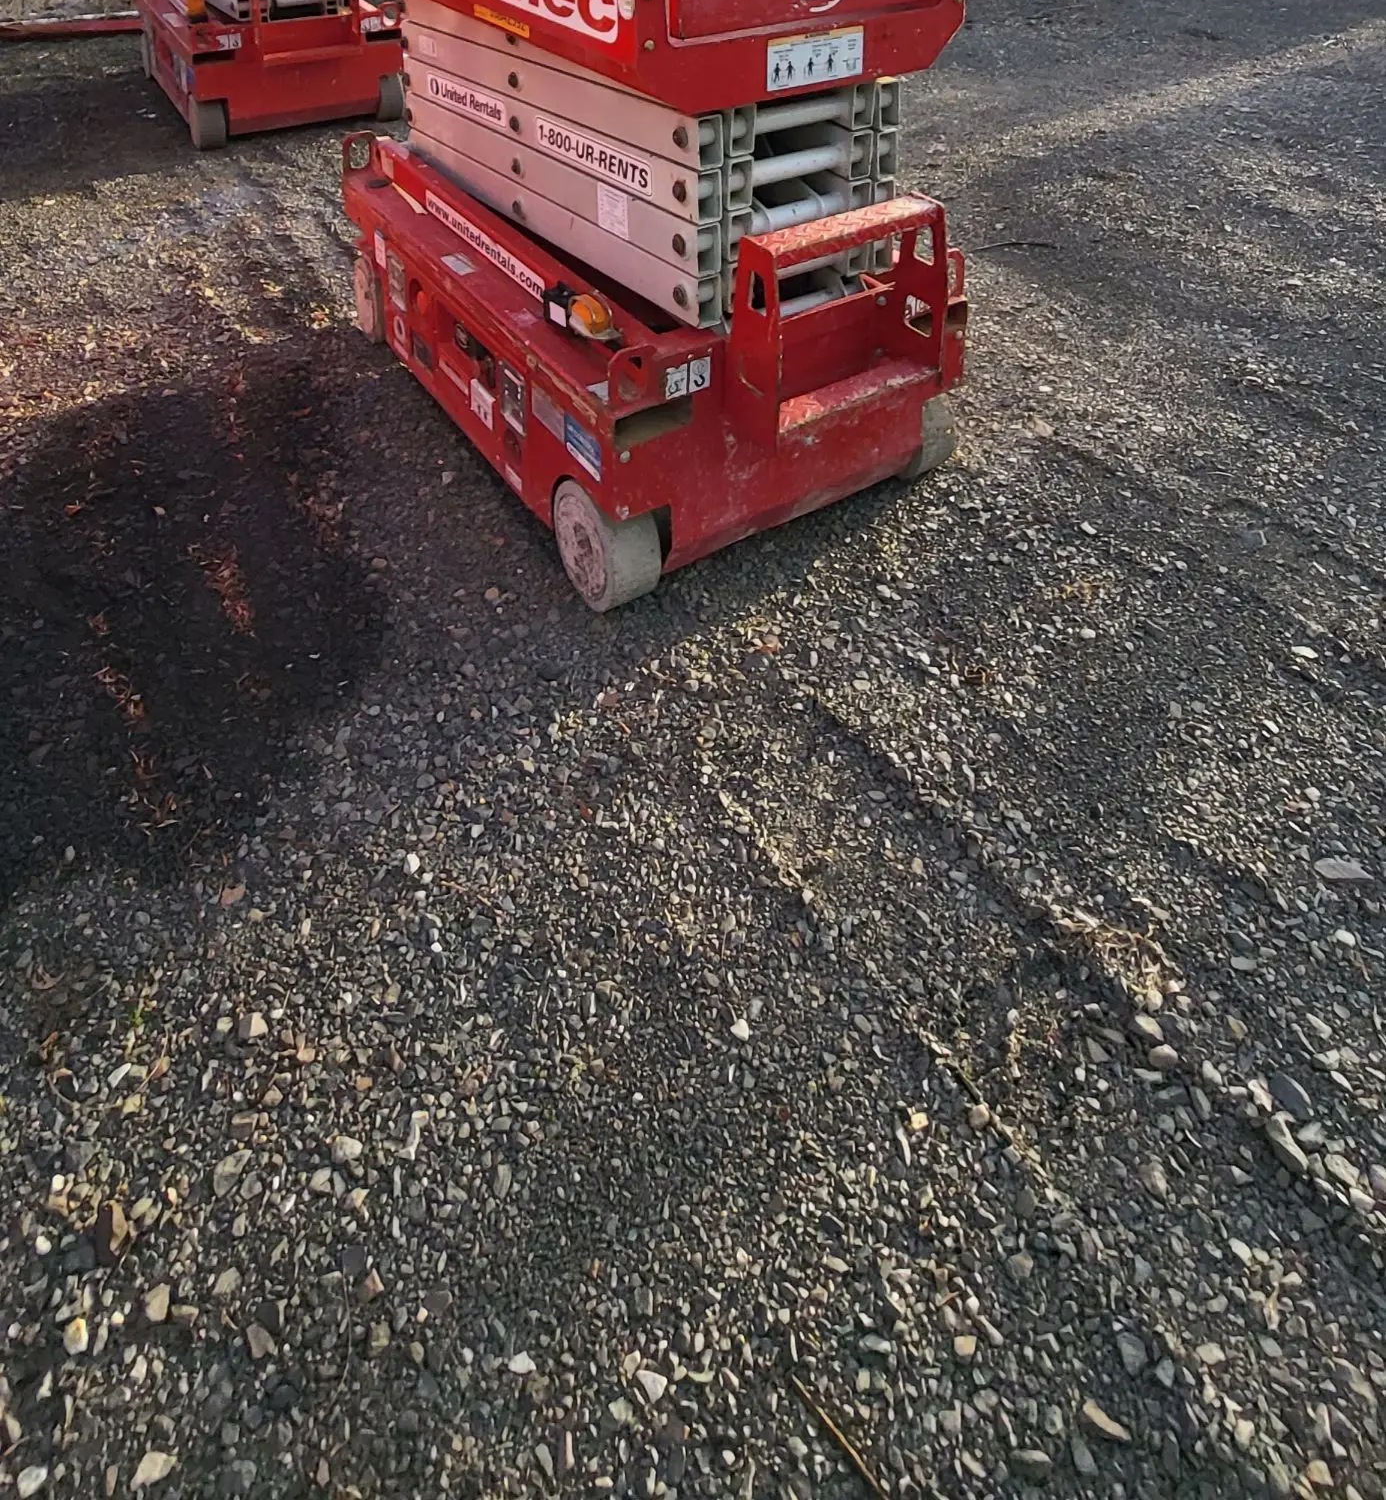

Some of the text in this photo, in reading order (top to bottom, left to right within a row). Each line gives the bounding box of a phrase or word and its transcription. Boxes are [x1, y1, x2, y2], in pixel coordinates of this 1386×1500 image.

[441, 82, 502, 121] United Rentals
[538, 125, 649, 189] 1-800-UR-RENTS
[427, 198, 543, 296] www.unitedrentals.com
